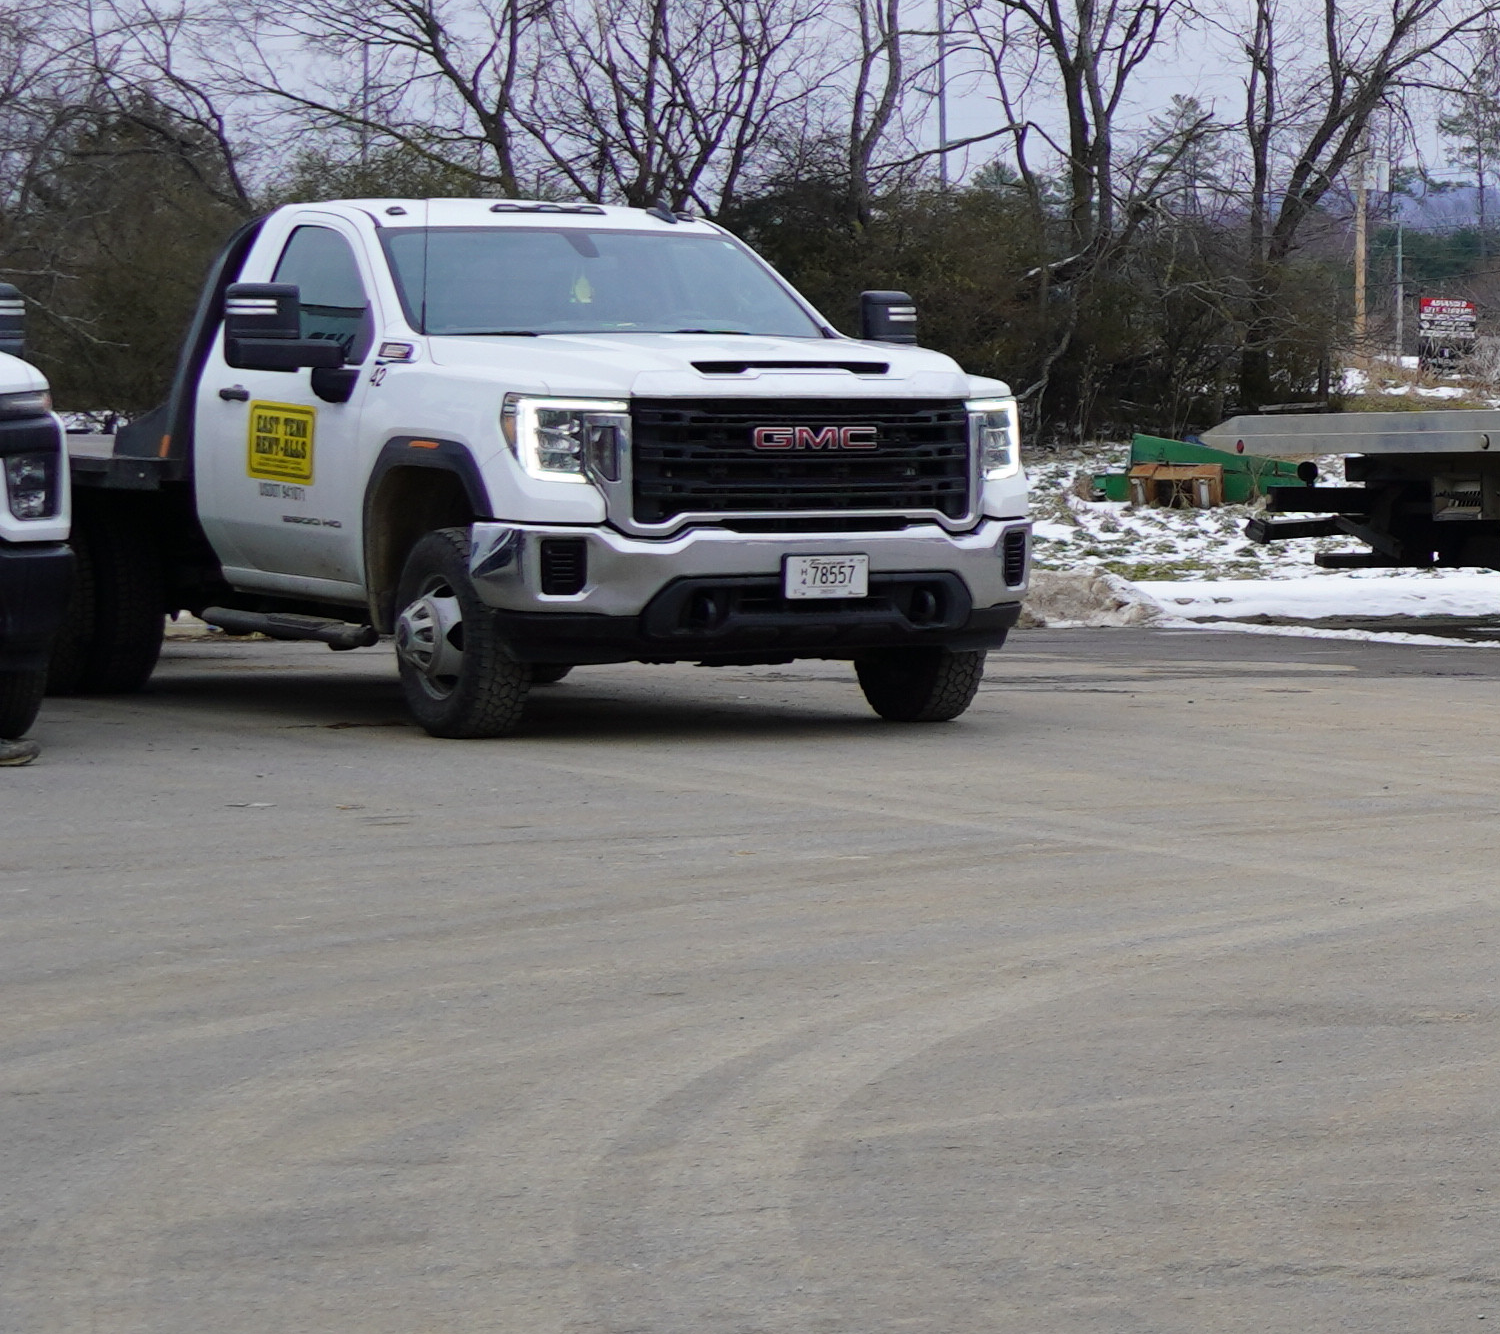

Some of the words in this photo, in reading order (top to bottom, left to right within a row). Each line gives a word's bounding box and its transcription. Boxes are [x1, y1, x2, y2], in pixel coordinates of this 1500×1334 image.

[369, 367, 386, 387] 42
[256, 414, 280, 434] EAST
[754, 427, 877, 449] GMC
[811, 565, 856, 585] 78557
